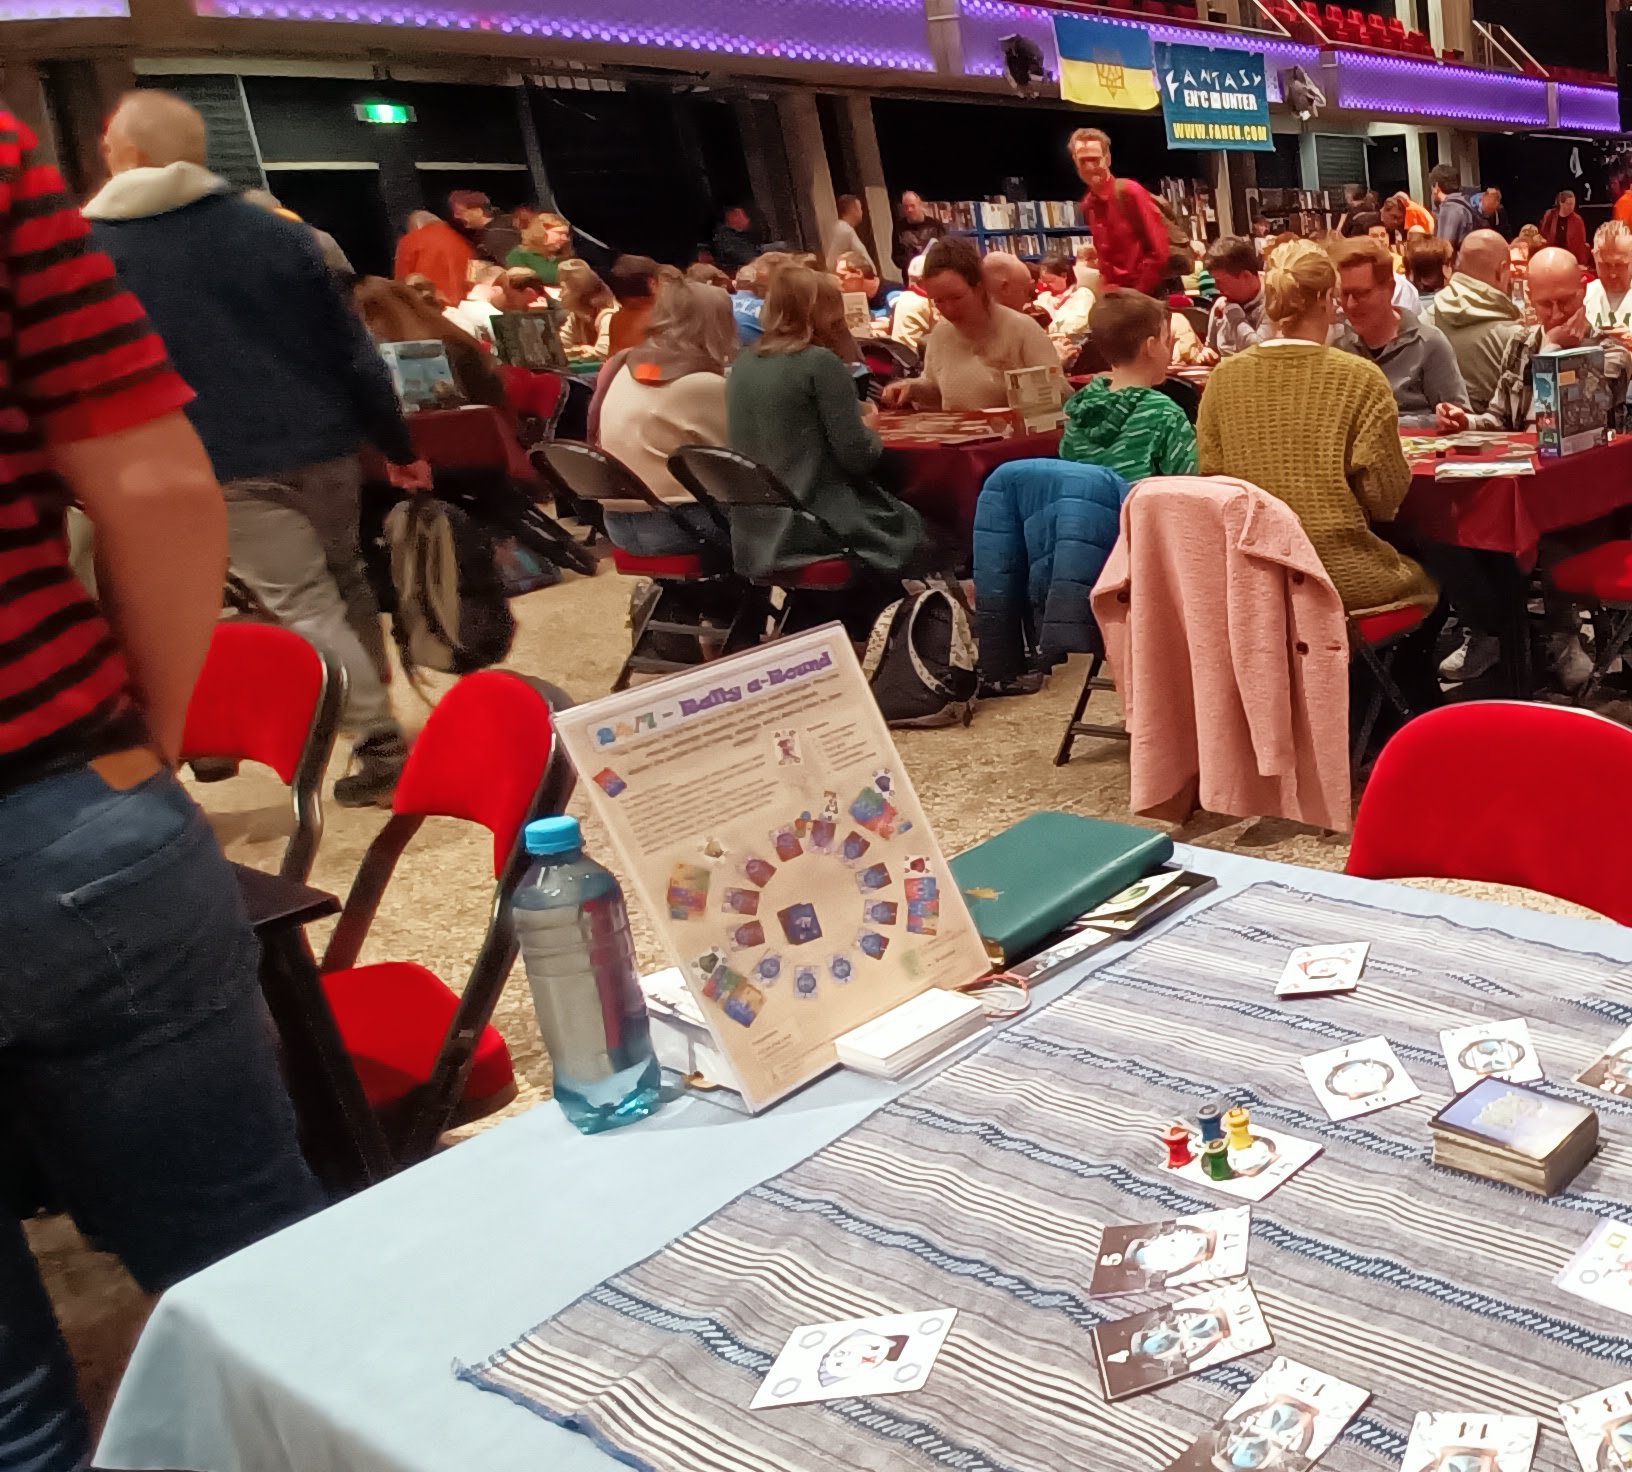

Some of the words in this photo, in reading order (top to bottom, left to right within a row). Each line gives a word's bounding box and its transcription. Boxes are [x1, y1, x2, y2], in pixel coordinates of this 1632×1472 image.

[1166, 69, 1261, 103] FANTASY
[1100, 1252, 1123, 1267] 5
[1234, 1304, 1255, 1326] 16
